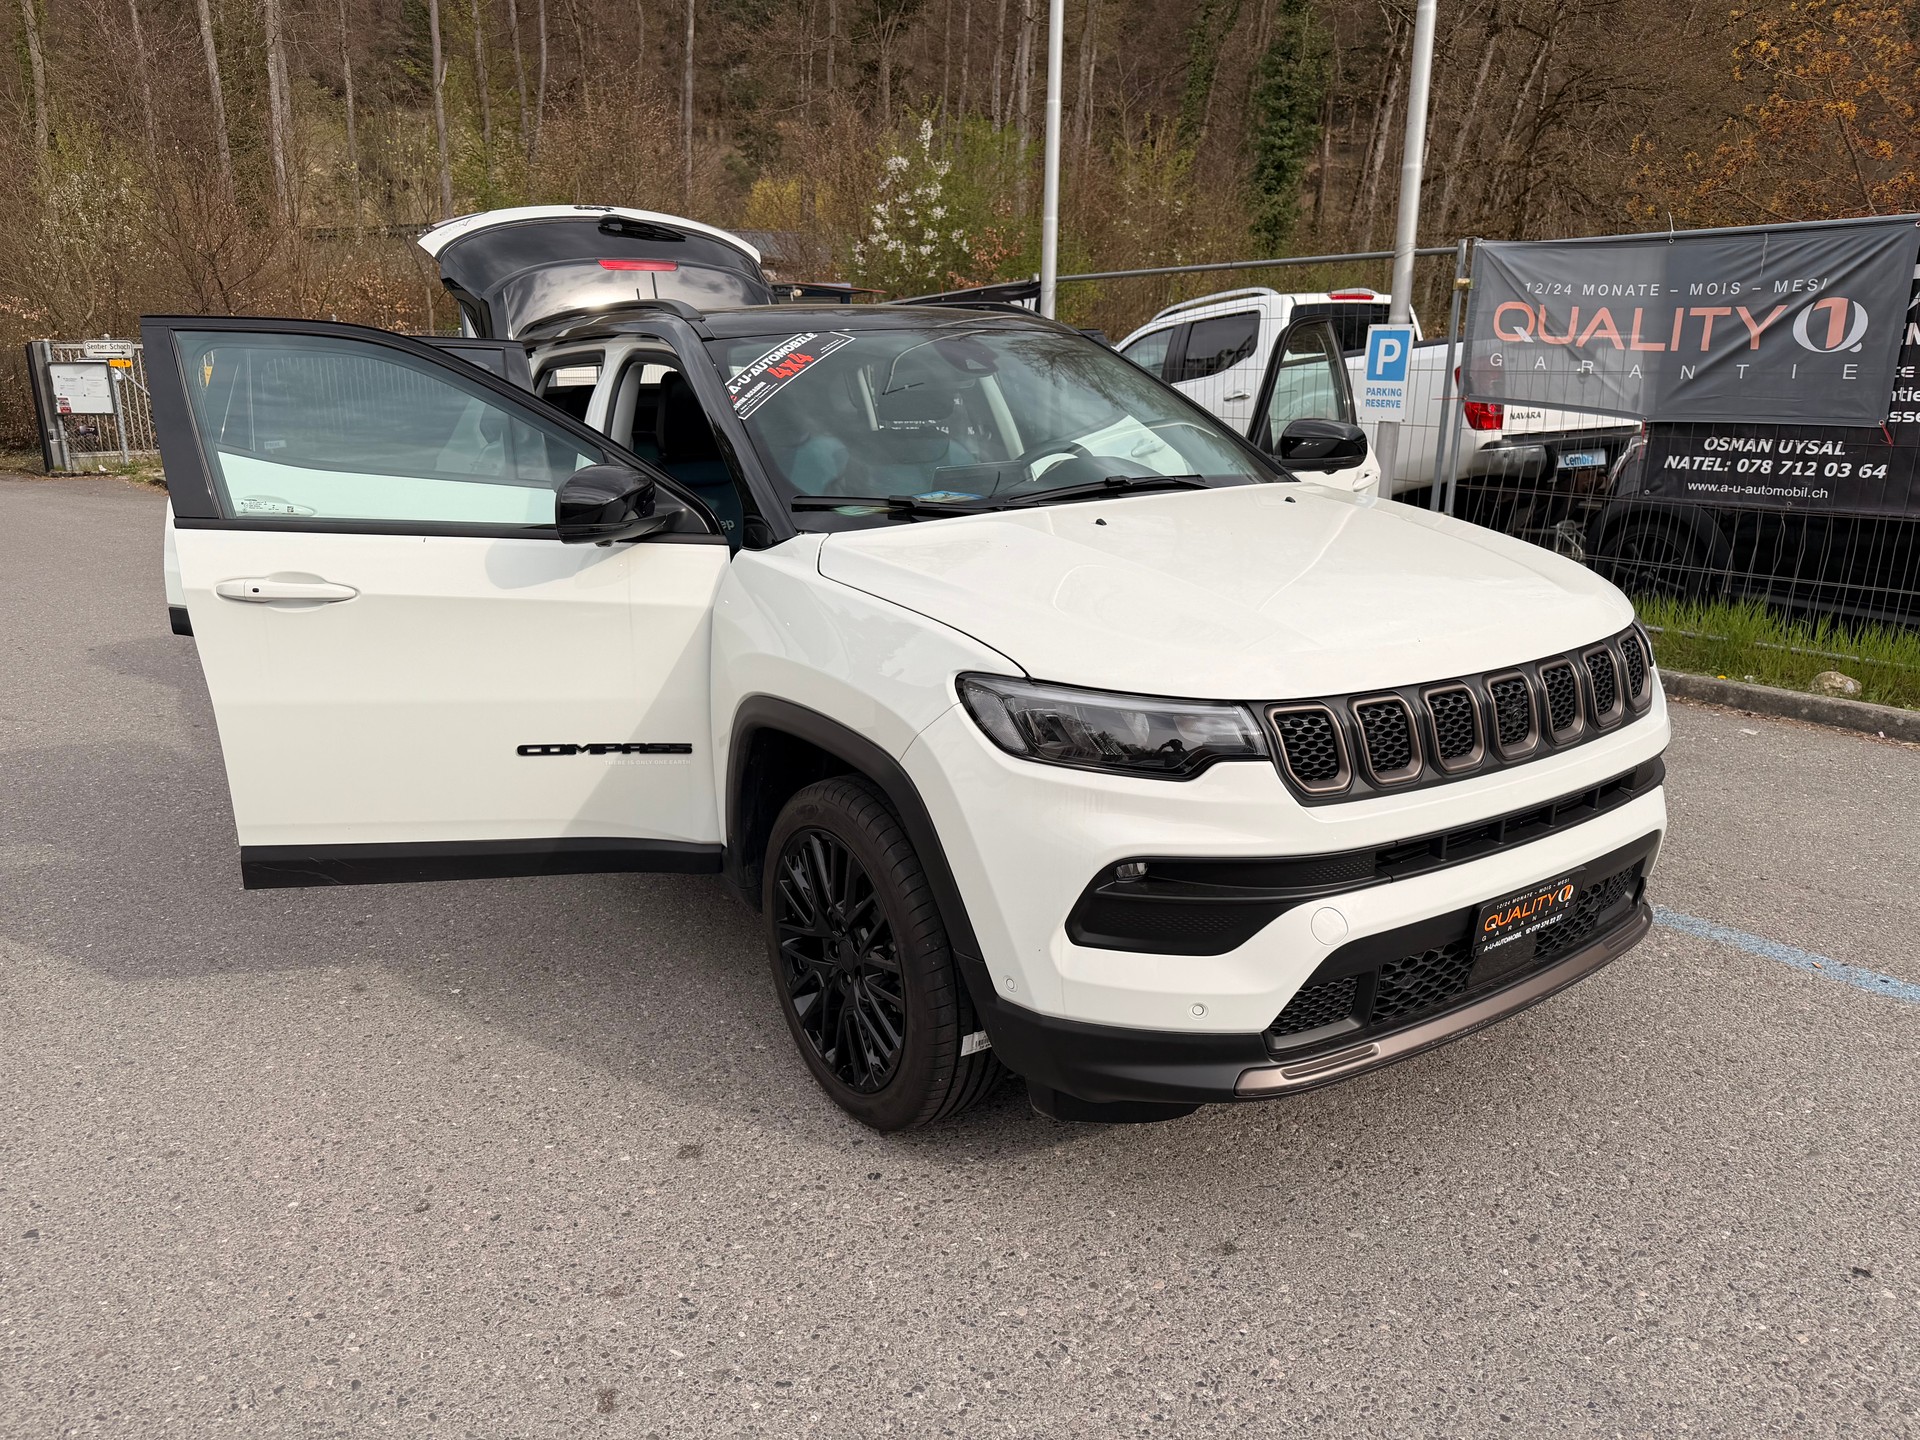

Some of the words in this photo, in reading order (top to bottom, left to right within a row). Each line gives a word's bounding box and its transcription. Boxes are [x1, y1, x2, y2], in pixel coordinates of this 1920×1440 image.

[1525, 281, 1573, 295] 12/24
[1582, 283, 1661, 297] MONATE
[1690, 282, 1742, 295] MOIS
[1774, 278, 1829, 293] MESI
[1493, 301, 1788, 352] QUALITY
[1376, 338, 1401, 375] P
[1490, 352, 1859, 380] GARANTIE
[1366, 387, 1402, 397] PARKING
[1365, 399, 1401, 408] RESERVE
[1510, 411, 1541, 420] NAVARA
[1704, 437, 1773, 453] OSMAN
[1779, 439, 1846, 455] UYSAL
[1664, 455, 1731, 472] NATEL:
[1736, 459, 1773, 474] 078
[1778, 461, 1817, 476] 712
[1824, 462, 1852, 478] 03
[1858, 464, 1888, 479] 64
[1687, 481, 1829, 499] www.a-u-automobil.ch
[517, 743, 693, 756] COMPASS
[1512, 891, 1533, 904] MONATE
[1539, 884, 1552, 893] MOIS
[1557, 878, 1570, 886] MESI
[1484, 889, 1559, 932] QUALITY
[1482, 901, 1569, 942] GARANTIE
